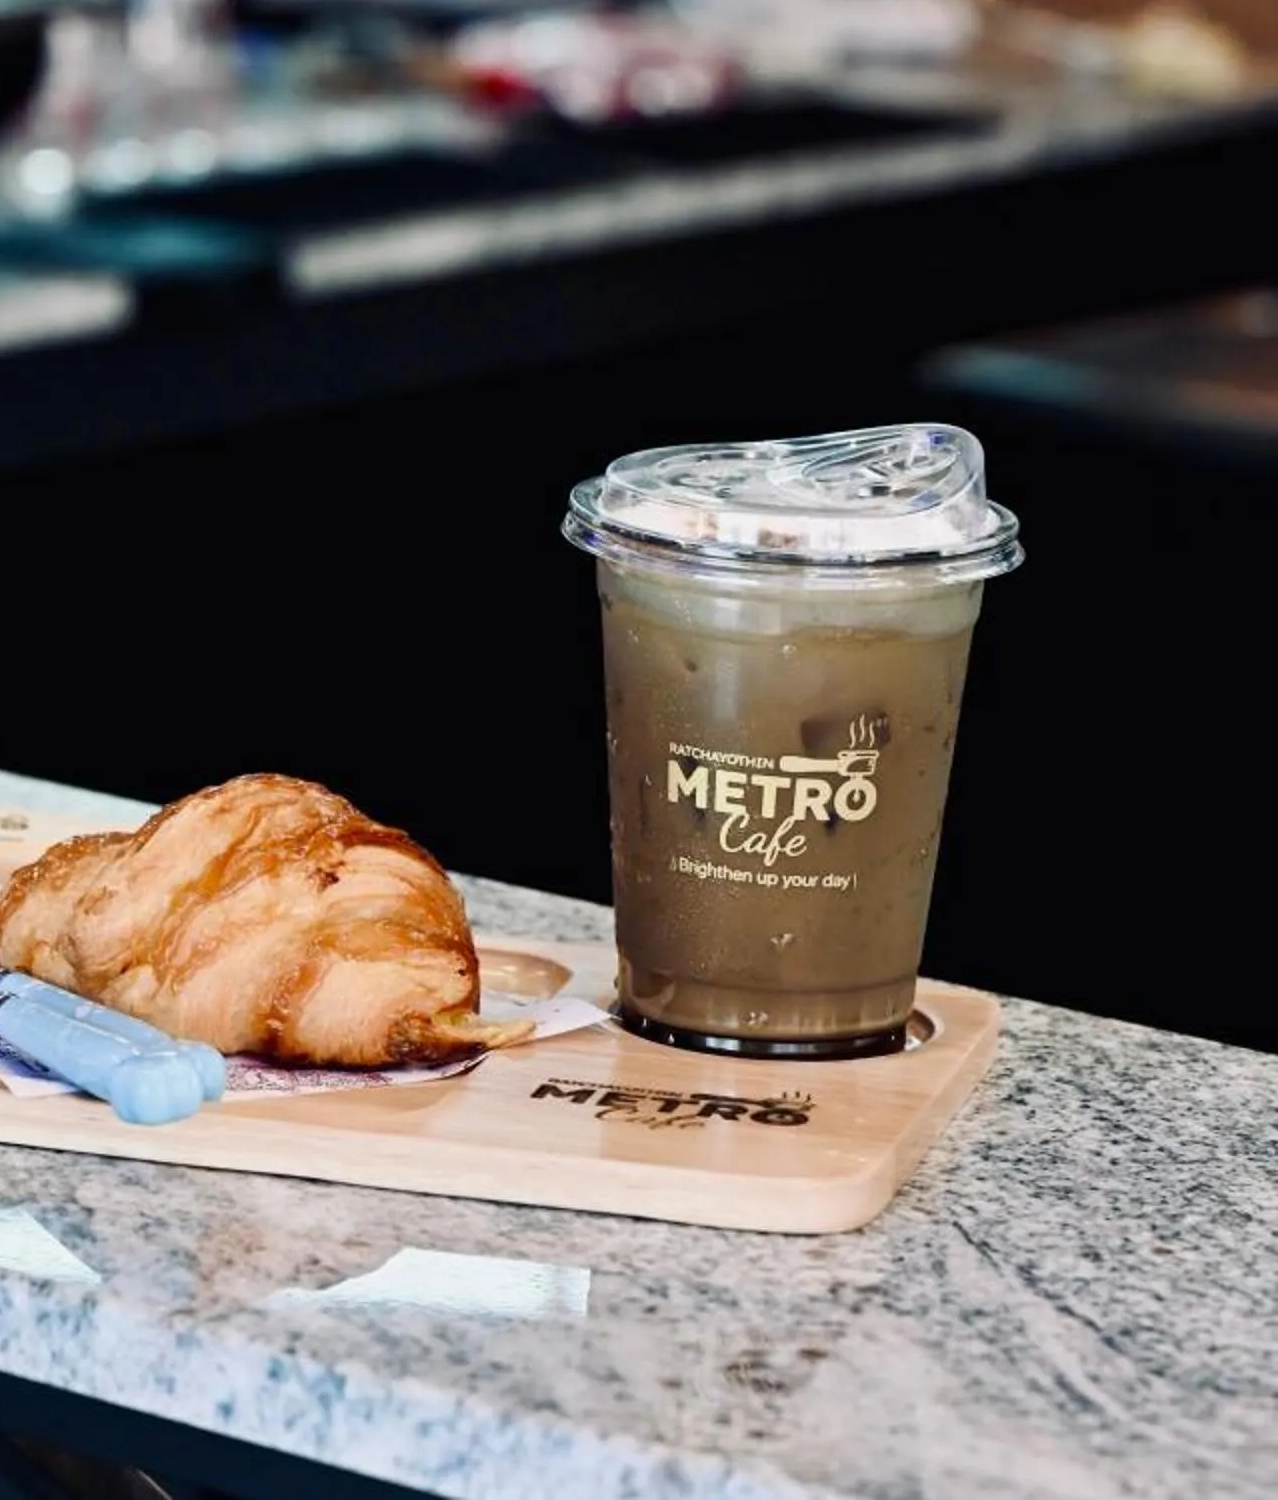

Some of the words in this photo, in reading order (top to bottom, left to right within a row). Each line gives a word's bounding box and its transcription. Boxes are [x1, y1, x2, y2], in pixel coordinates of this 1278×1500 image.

[668, 741, 775, 770] RATCHAYOTHIN
[666, 758, 878, 822] METRO
[719, 812, 807, 866] Cafe
[756, 872, 779, 888] up
[782, 873, 819, 890] your
[821, 872, 852, 891] day
[530, 1083, 810, 1127] METRO
